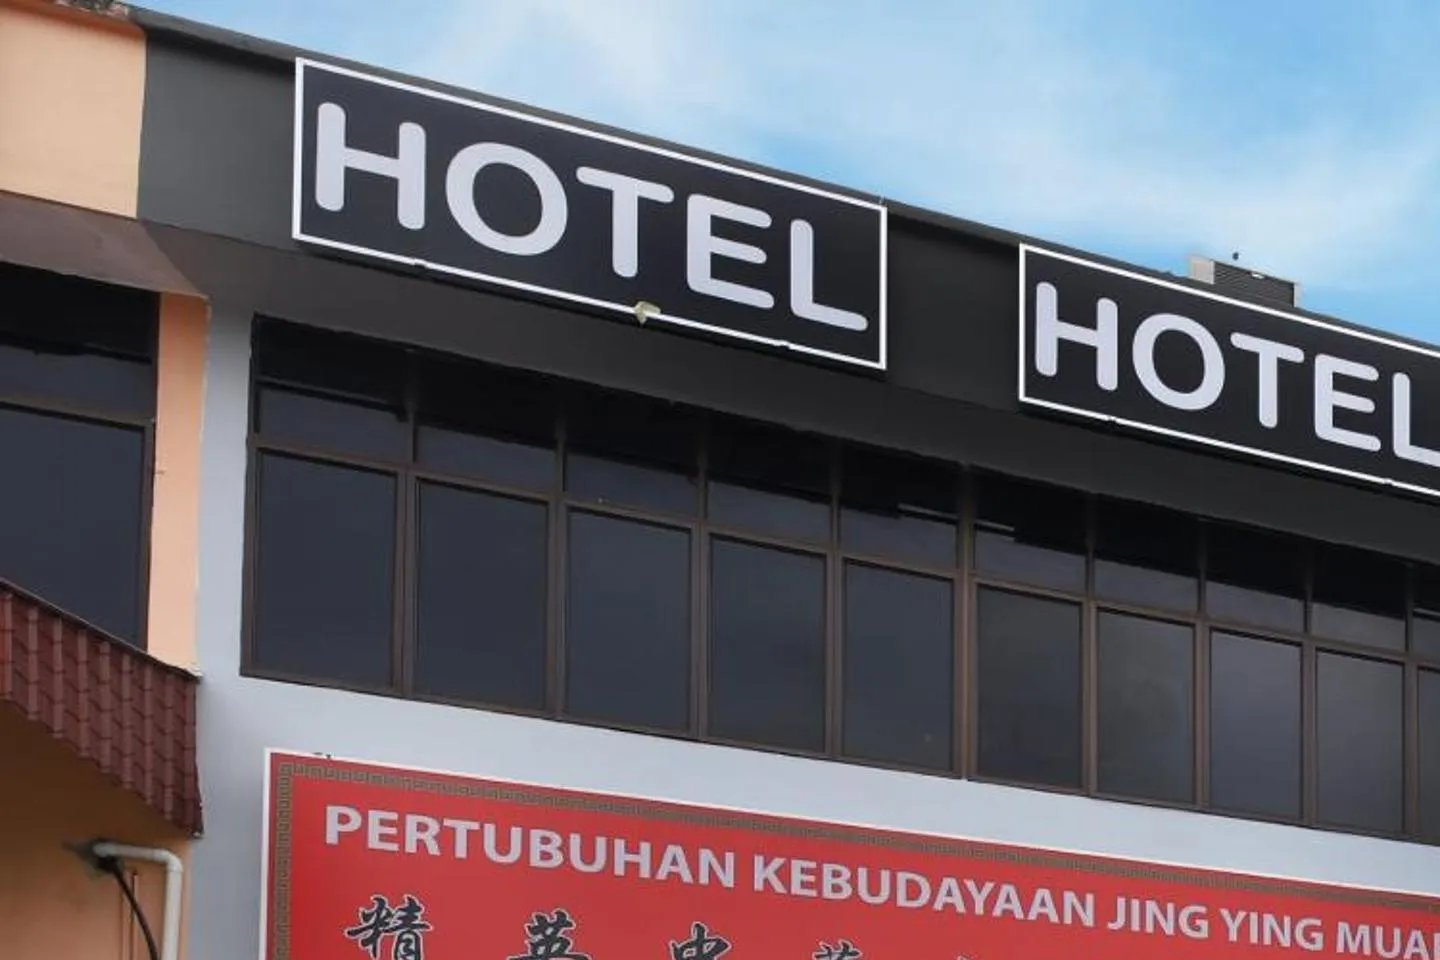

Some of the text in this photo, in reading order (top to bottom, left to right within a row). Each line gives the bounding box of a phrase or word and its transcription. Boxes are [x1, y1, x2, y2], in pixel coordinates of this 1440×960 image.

[315, 102, 868, 330] HOTEL
[325, 805, 734, 888] PERTUBUHAN
[753, 857, 1095, 927] KEBUDAYAAN
[1107, 897, 1209, 939] JING
[1220, 910, 1324, 952] YING
